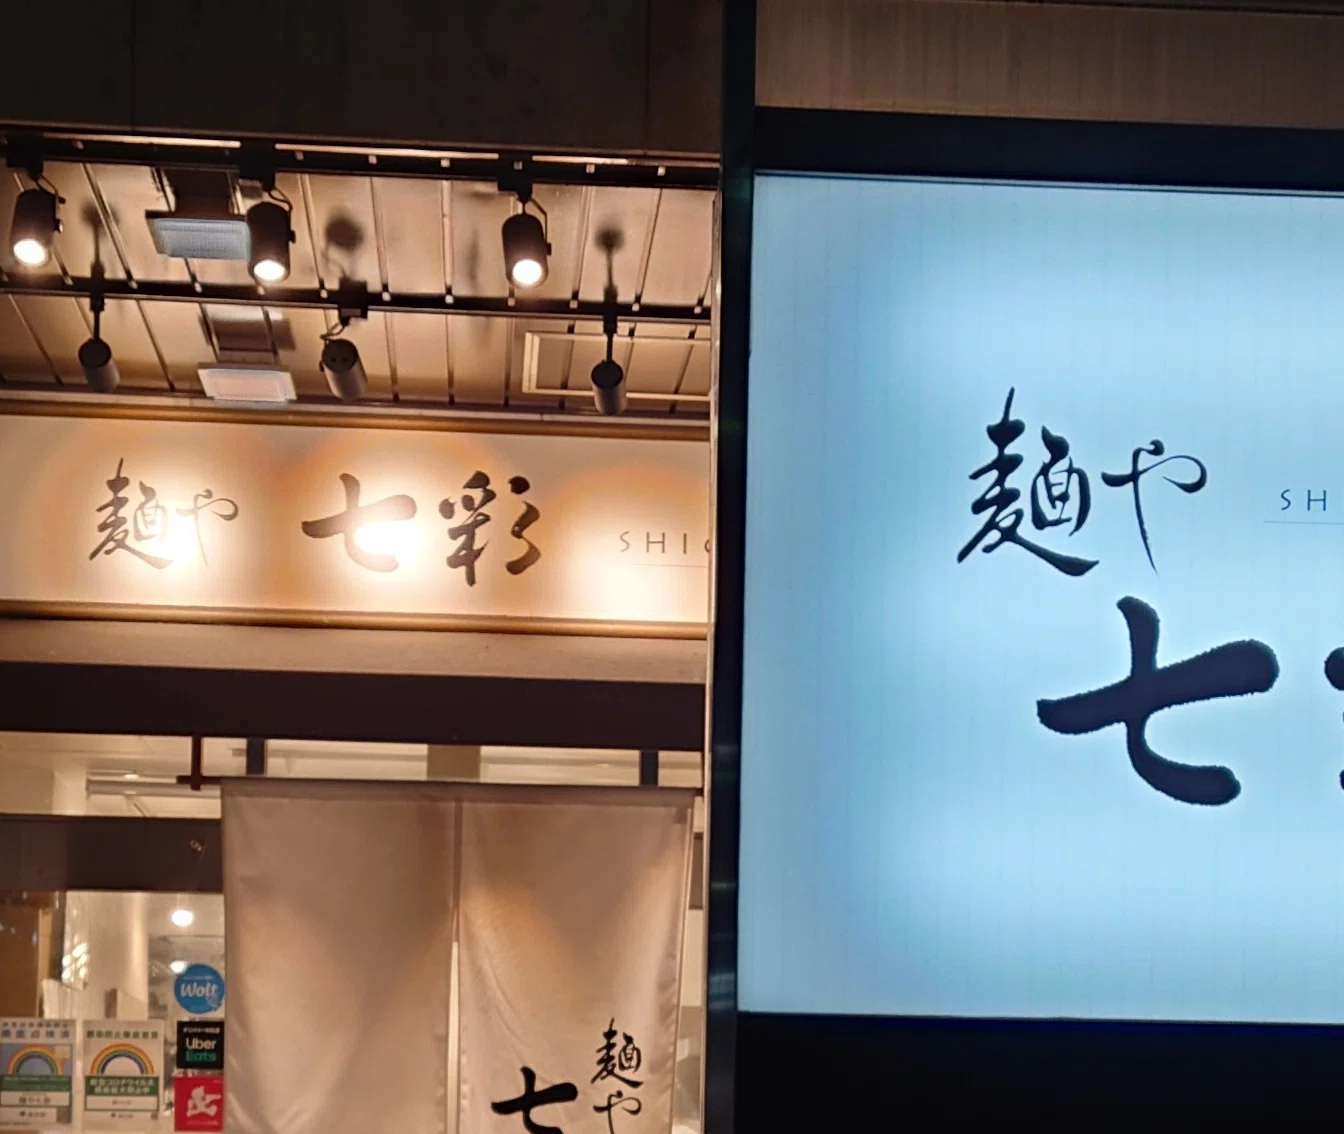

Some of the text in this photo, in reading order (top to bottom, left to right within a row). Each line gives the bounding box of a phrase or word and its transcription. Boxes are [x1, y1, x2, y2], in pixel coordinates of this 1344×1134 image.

[300, 470, 543, 587] 七彩
[180, 982, 219, 998] Wolt
[185, 1036, 217, 1050] Uber
